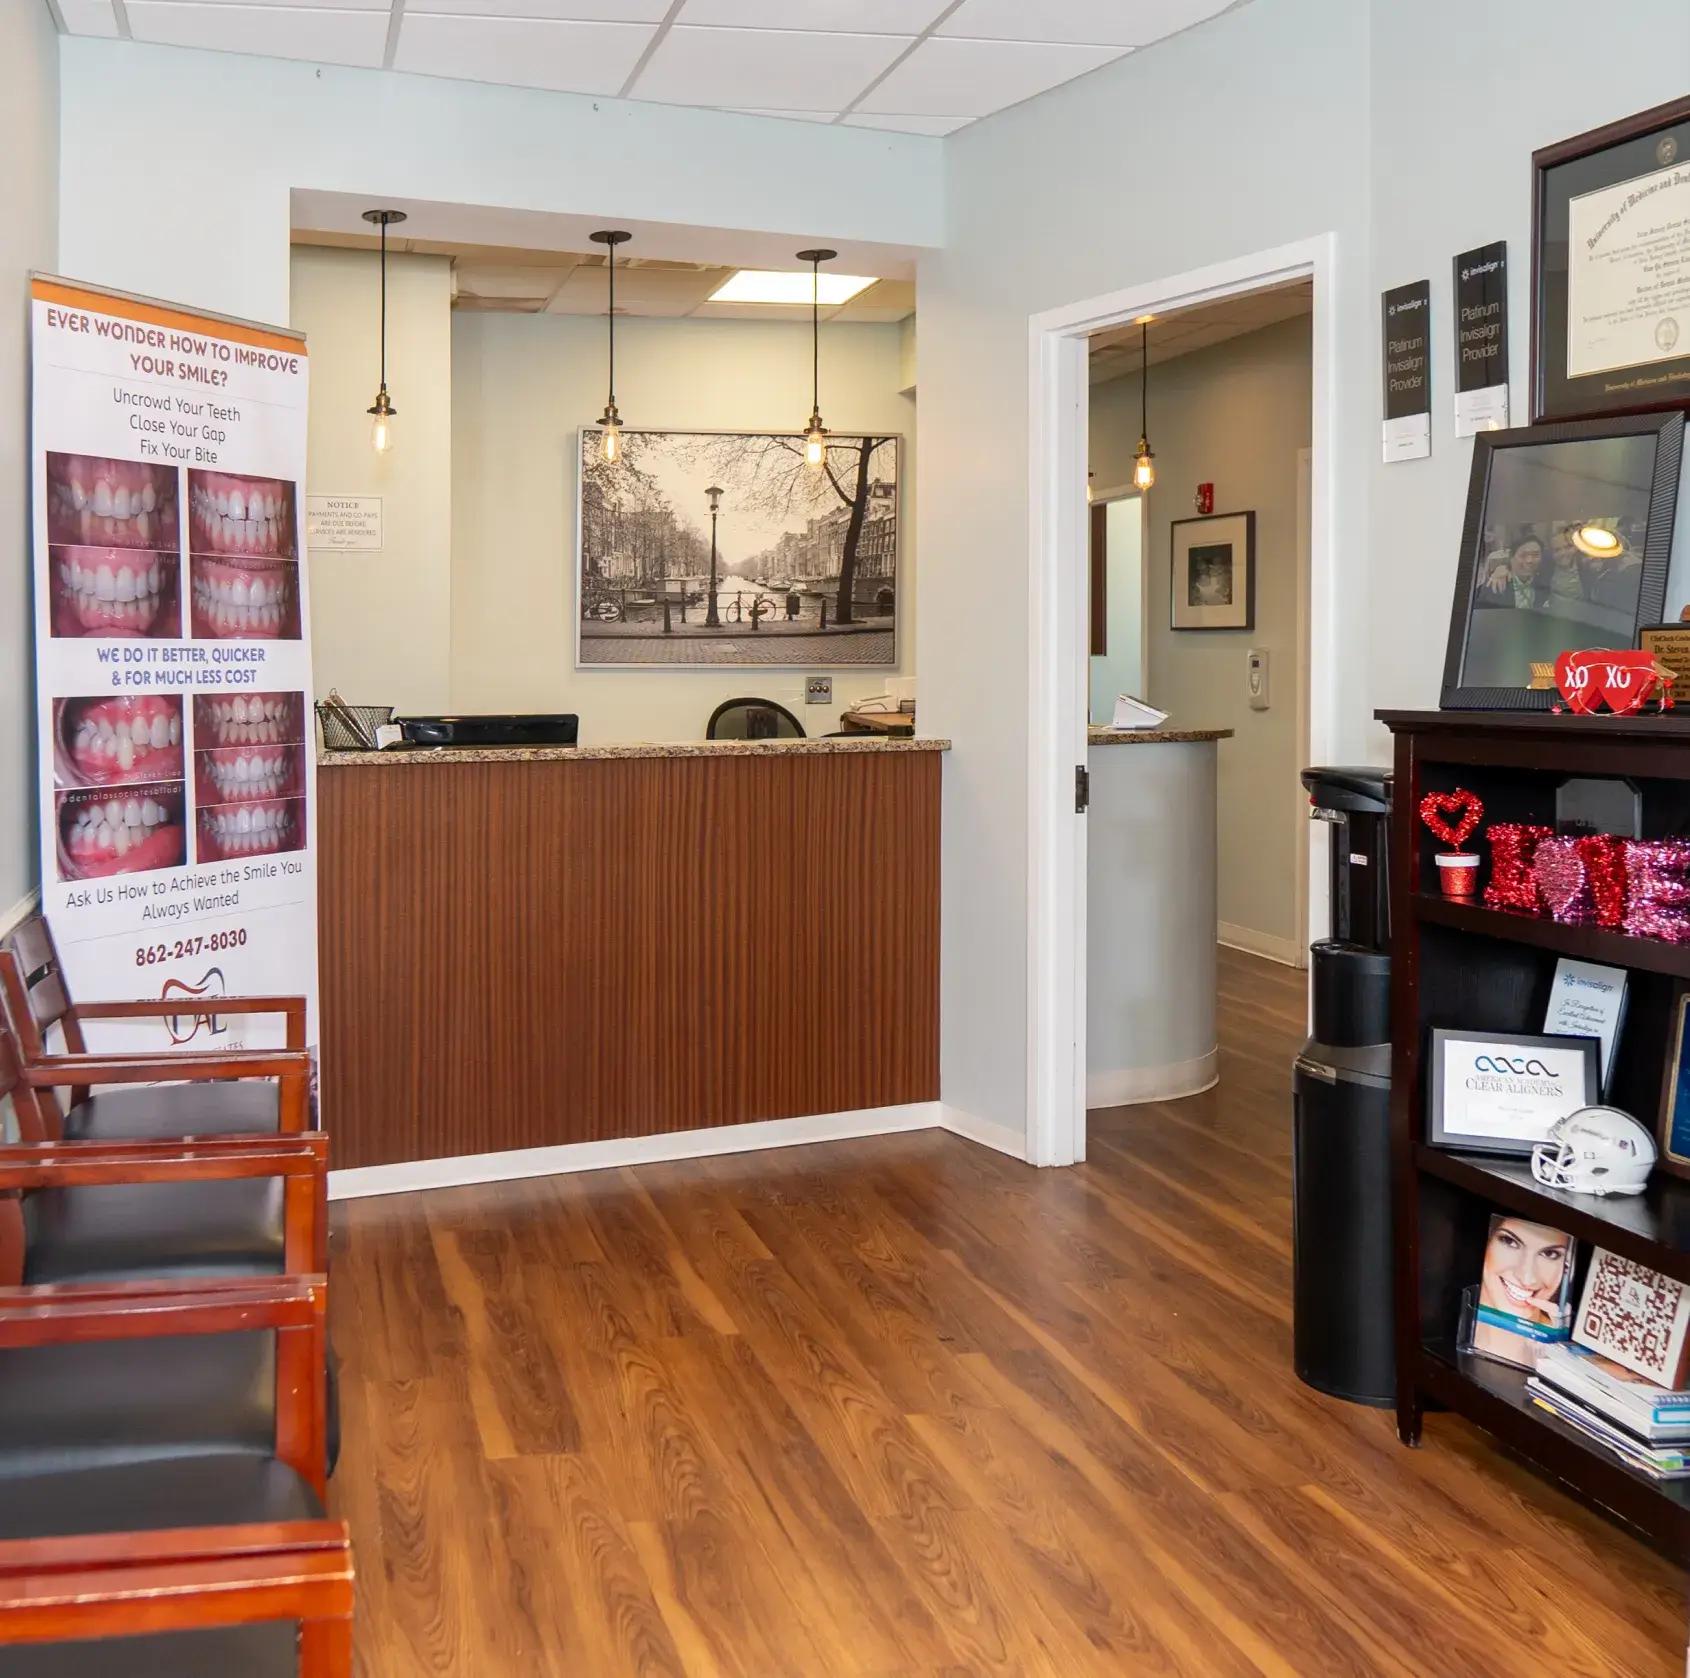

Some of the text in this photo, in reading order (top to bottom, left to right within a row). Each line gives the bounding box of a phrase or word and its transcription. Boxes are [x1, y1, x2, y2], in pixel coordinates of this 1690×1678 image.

[1461, 301, 1499, 322] Platinum
[47, 308, 298, 375] EVER WONDER HOW TO IMPROVE
[1460, 322, 1500, 343] Invisalign
[1389, 336, 1422, 355] Platinum
[1463, 342, 1499, 362] Provider
[130, 353, 228, 388] YOUR SMILE?
[1388, 355, 1423, 374] Invisalign
[1390, 374, 1422, 392] Provider
[113, 387, 241, 422] Uncrowd Your Teeth
[130, 414, 226, 445] Close Your Gap
[140, 438, 218, 464] Fix Your Bite
[327, 501, 360, 509] NOTICE
[340, 511, 352, 519] AND
[97, 647, 266, 664] WE DO IT BETTER, QUICKER
[111, 669, 257, 686] & FOR MUCH LESS COST
[1565, 666, 1588, 688] XO
[66, 858, 302, 909] Ask Us How to Achieve the Smile You
[141, 889, 240, 921] Always Wanted
[135, 928, 247, 968] 862-247-8030
[1576, 976, 1614, 993] invisalign
[1465, 1077, 1564, 1098] CLEAR ALIGNERS
